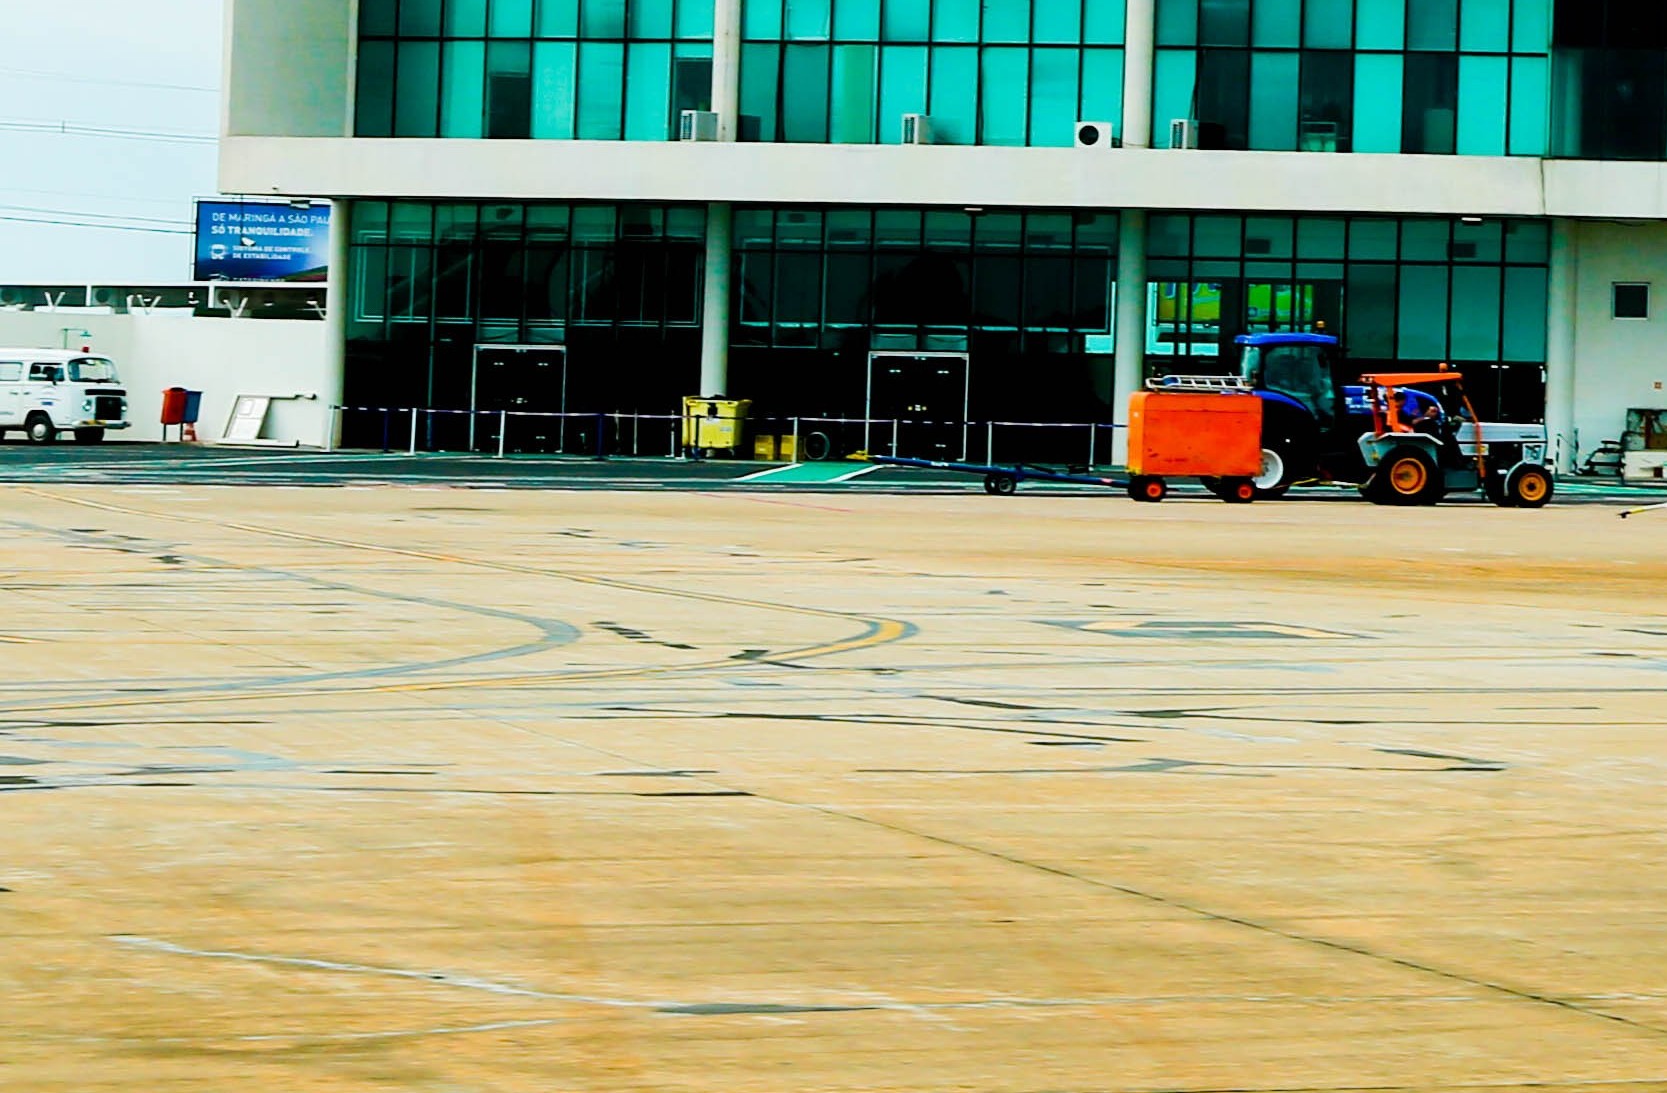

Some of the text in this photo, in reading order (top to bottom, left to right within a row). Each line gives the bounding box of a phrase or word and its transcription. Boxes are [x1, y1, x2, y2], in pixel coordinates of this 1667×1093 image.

[212, 212, 226, 222] DE
[278, 215, 286, 223] A
[288, 212, 308, 224] SÃO
[211, 223, 226, 234] SÓ
